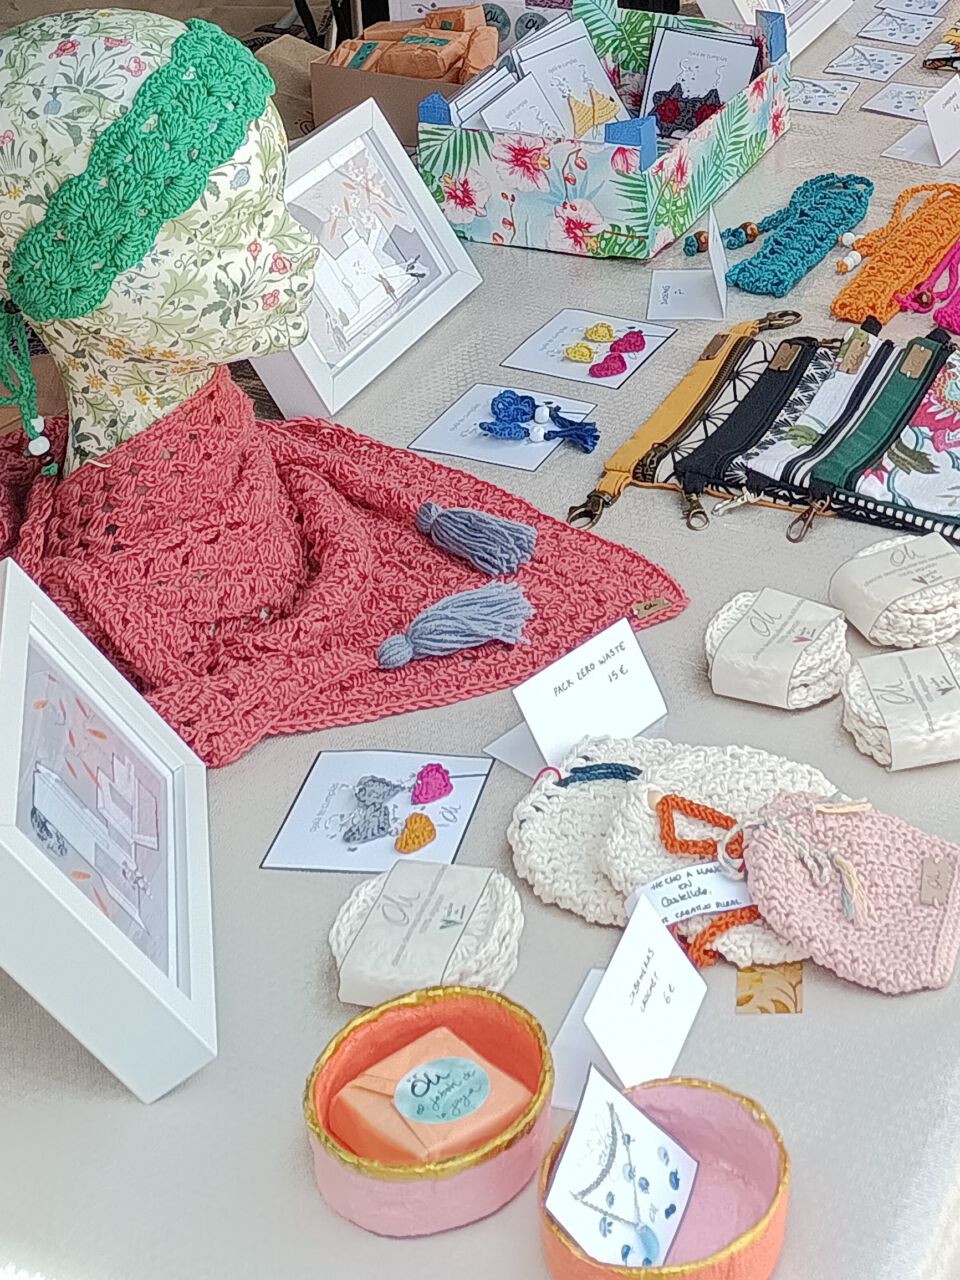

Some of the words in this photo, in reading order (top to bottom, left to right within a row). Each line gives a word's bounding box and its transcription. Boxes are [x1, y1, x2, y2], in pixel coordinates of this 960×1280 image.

[553, 678, 574, 697] PACK
[575, 662, 596, 681] ZERO
[597, 640, 626, 665] WASTE
[650, 873, 682, 891] HECHO
